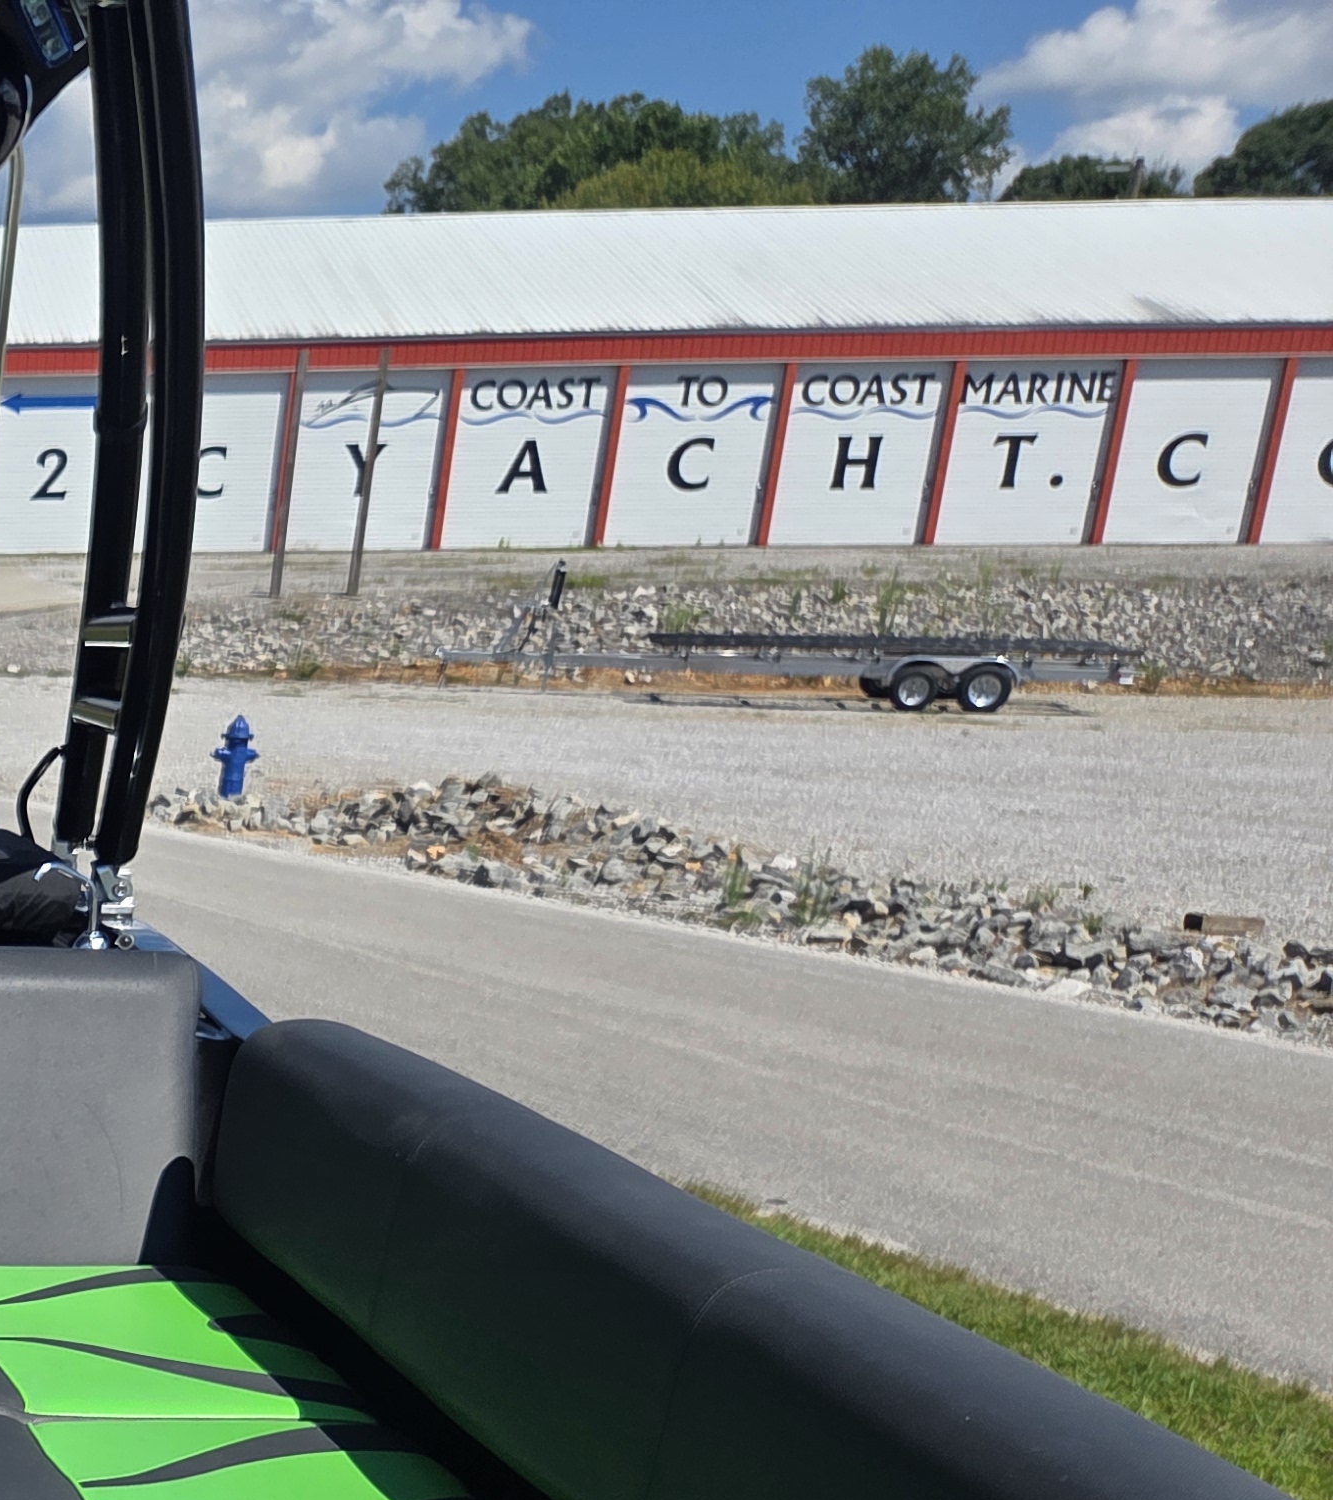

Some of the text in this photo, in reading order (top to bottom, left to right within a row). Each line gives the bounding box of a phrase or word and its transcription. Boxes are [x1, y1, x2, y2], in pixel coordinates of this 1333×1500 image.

[470, 371, 1116, 411] COAST TO COAST MARINE
